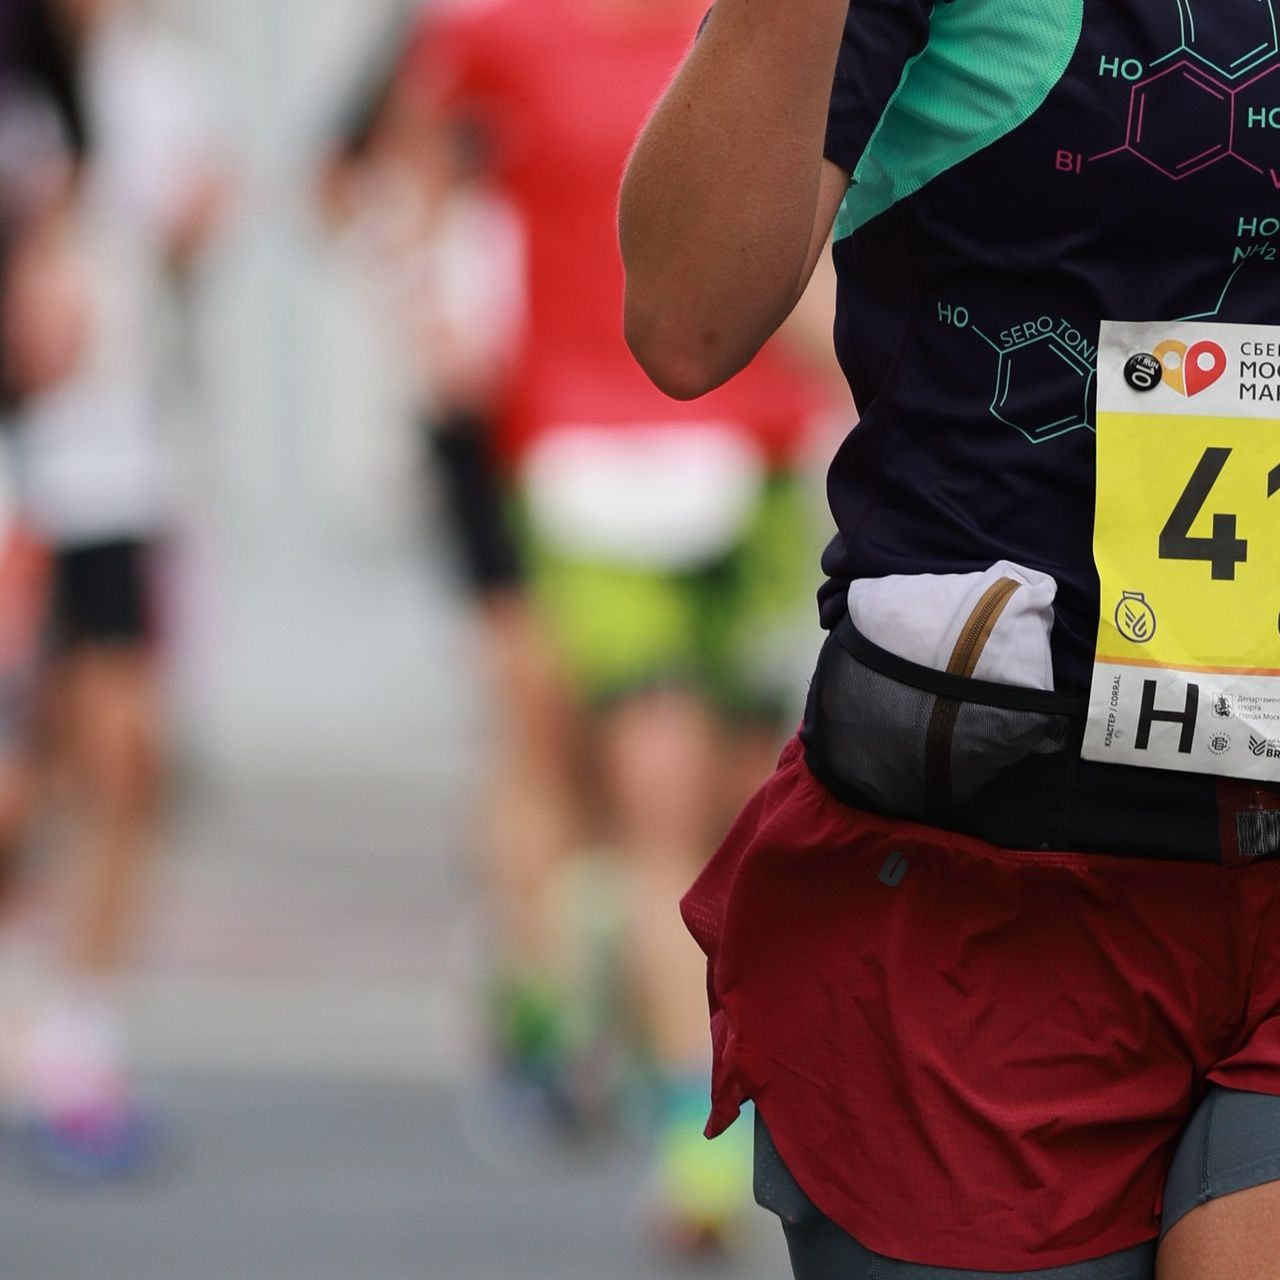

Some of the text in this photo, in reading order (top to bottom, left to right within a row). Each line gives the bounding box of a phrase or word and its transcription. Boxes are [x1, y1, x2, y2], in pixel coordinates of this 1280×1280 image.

[1099, 55, 1143, 80] HO
[1055, 149, 1082, 174] BI
[1237, 217, 1280, 237] HO
[938, 302, 969, 327] HO
[1000, 316, 1099, 363] SEROTONI
[1131, 364, 1155, 387] 10
[1104, 713, 1116, 747] КЛАСТЕР
[1110, 674, 1121, 707] CORRAL
[1134, 679, 1200, 754] H
